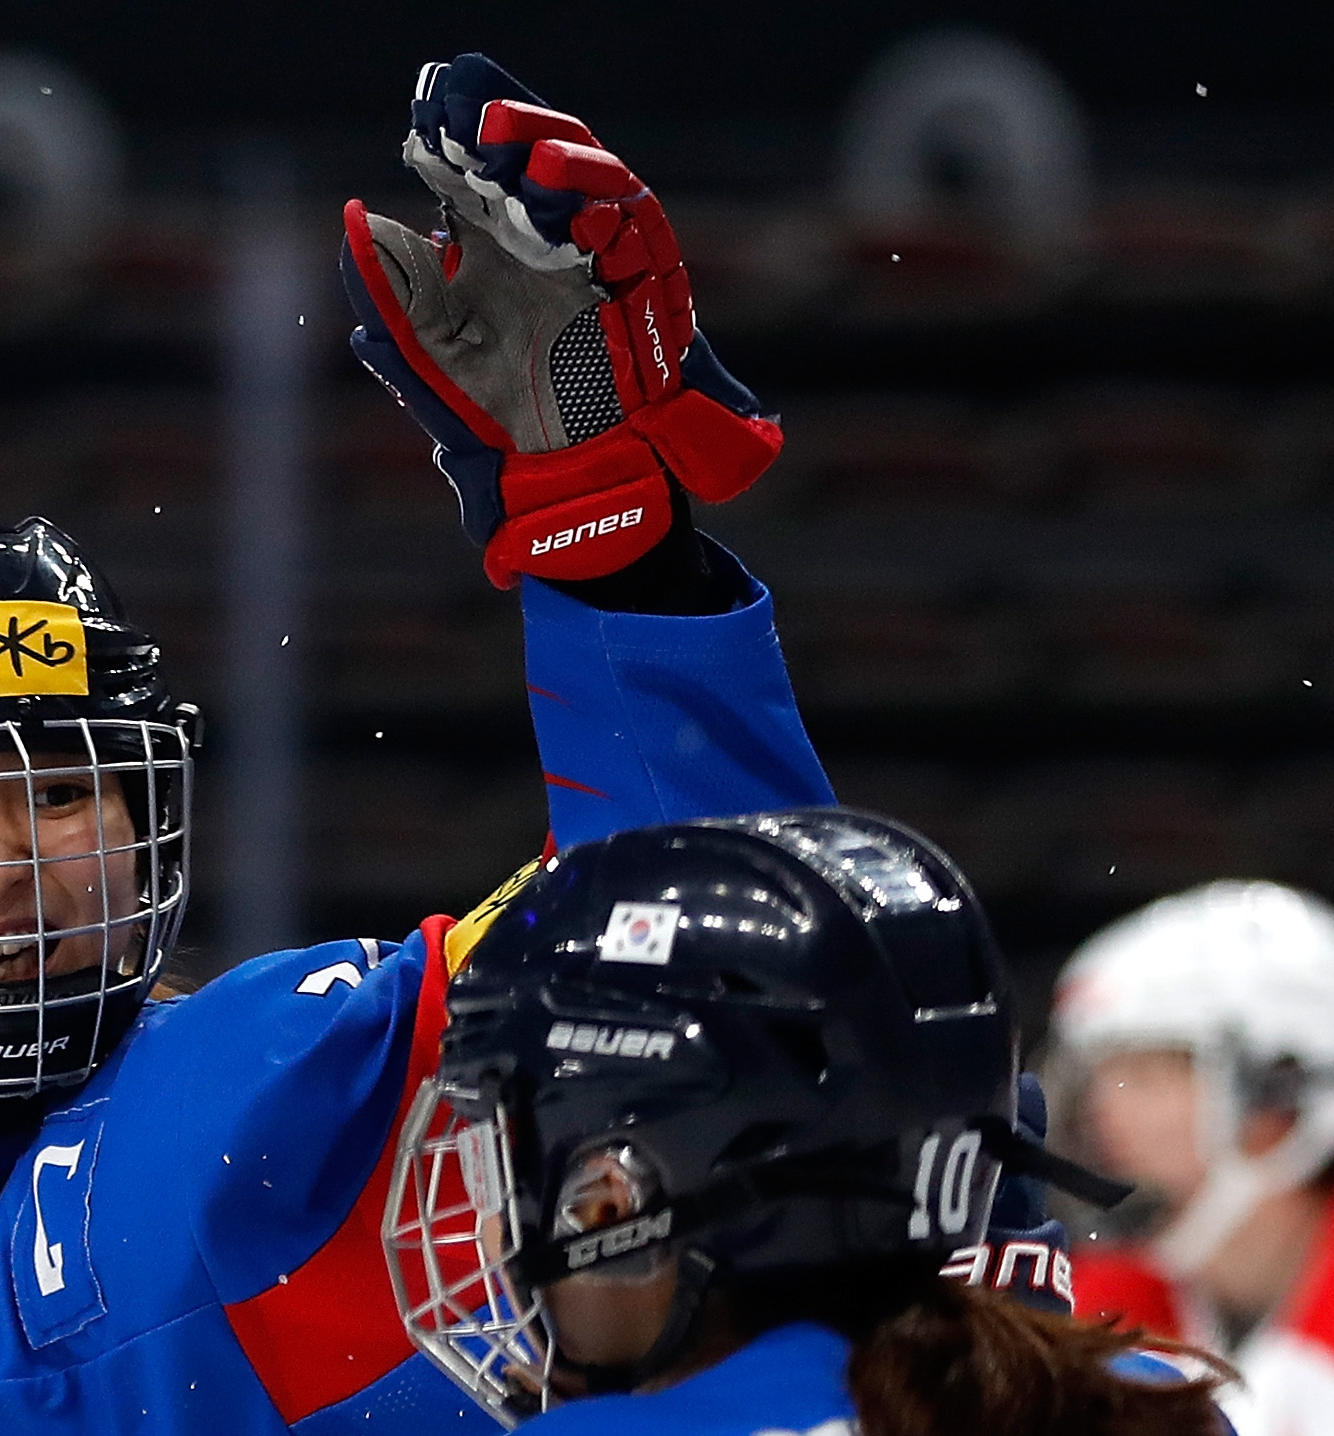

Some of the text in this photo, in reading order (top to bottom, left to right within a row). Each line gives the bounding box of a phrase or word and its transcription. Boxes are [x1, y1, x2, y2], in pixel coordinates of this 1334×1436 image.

[644, 299, 670, 388] VAPOR
[531, 506, 644, 556] BAUER
[33, 1140, 85, 1297] C
[908, 1131, 983, 1242] 10
